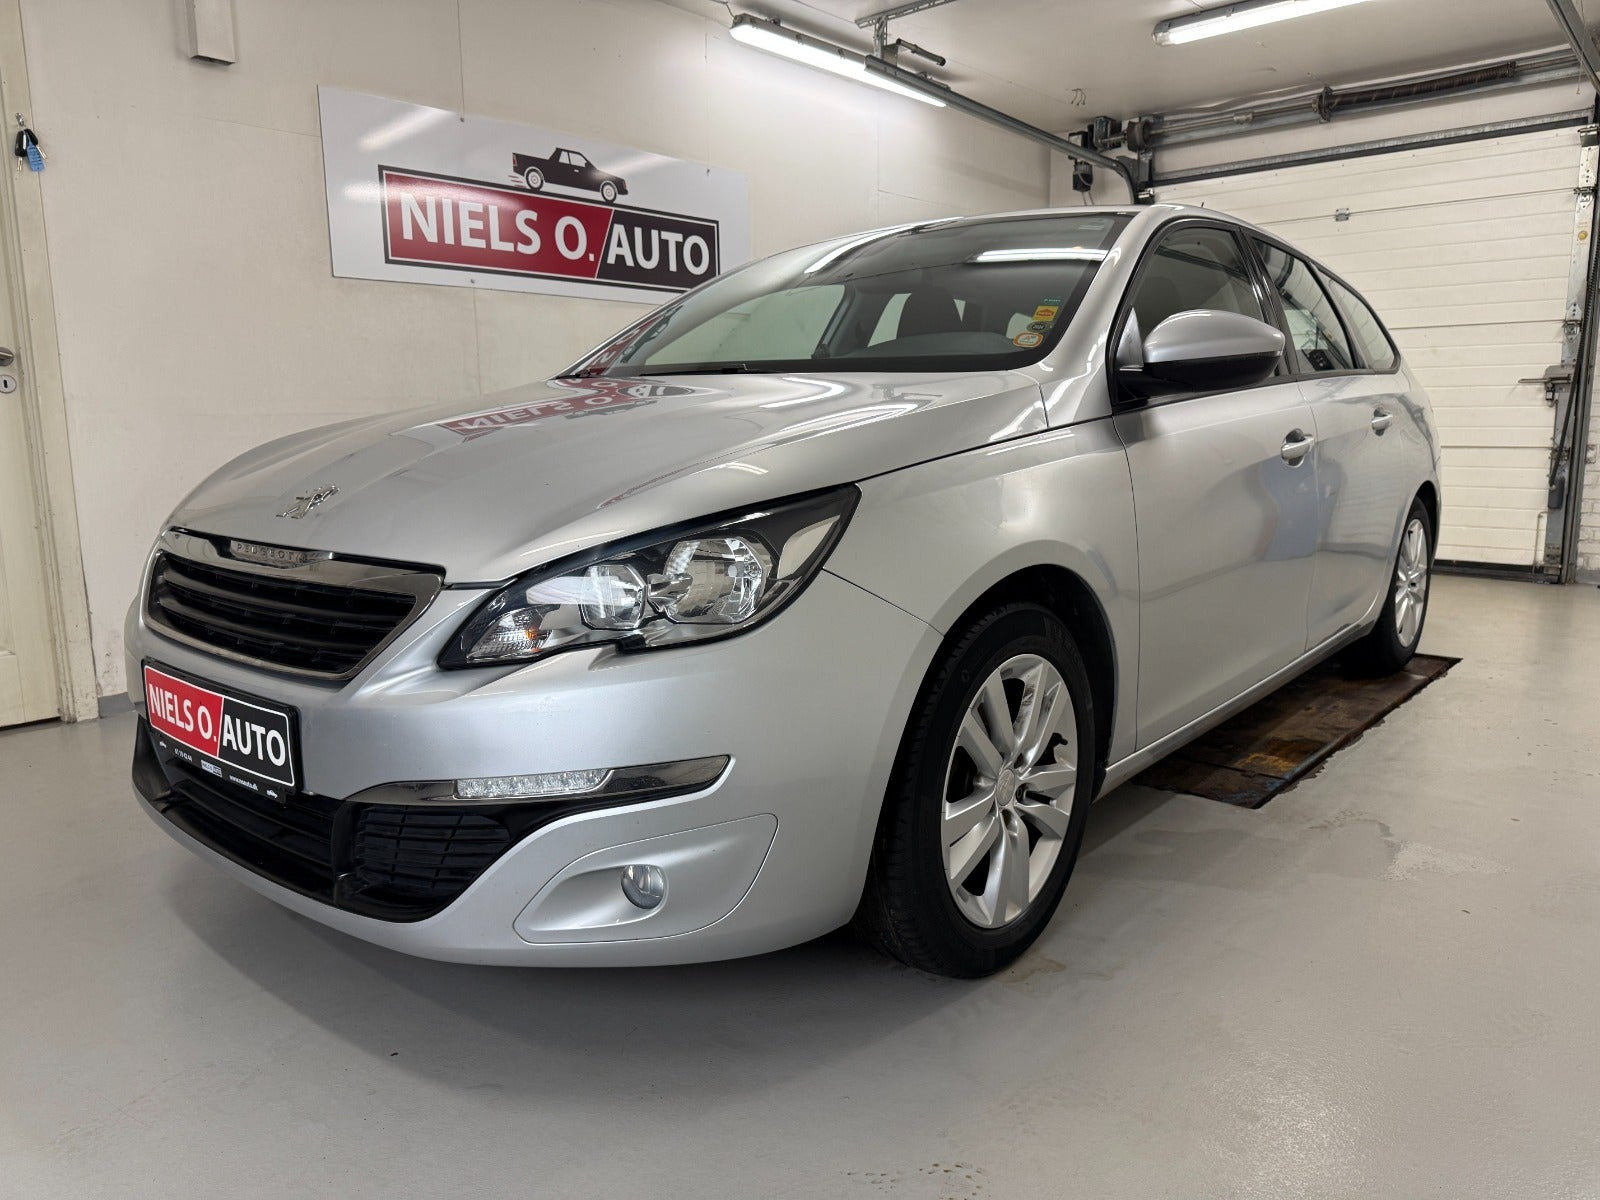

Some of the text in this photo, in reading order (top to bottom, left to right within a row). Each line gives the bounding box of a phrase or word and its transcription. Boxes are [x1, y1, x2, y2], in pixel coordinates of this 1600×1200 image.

[400, 192, 710, 276] NIELS O. AUTO
[148, 683, 286, 767] NIELS O. AUTO
